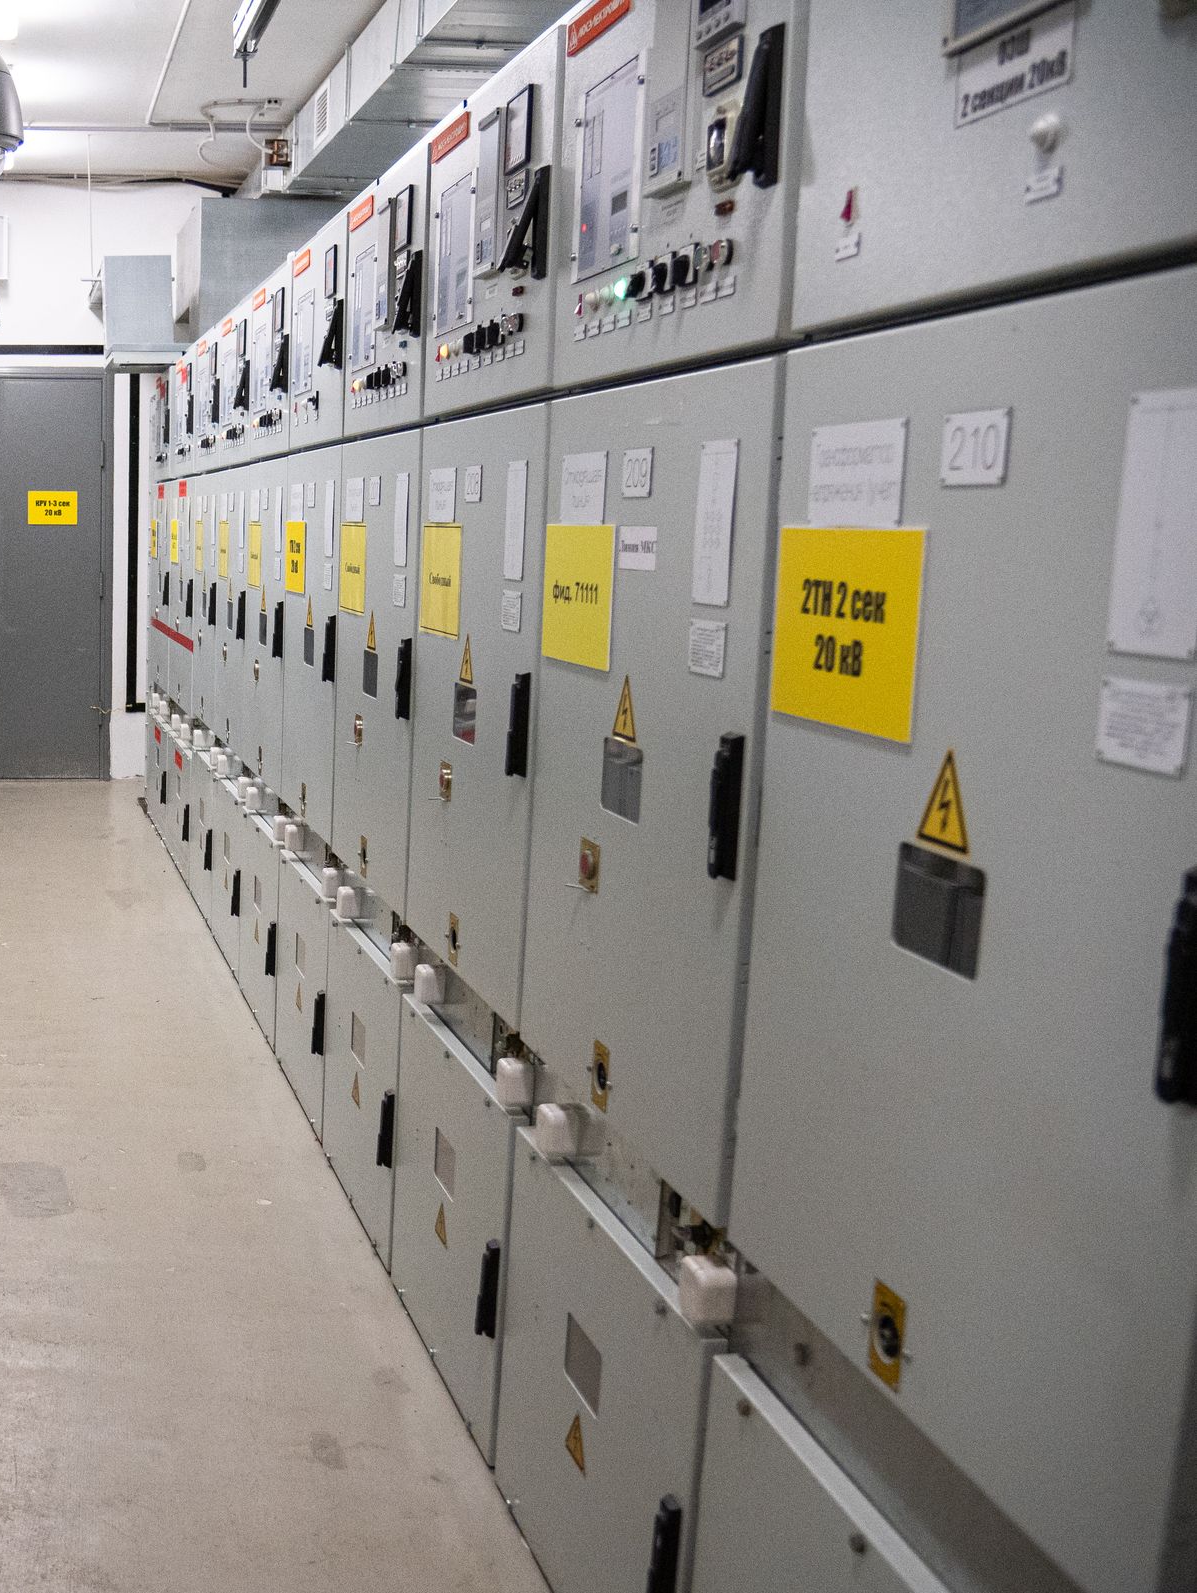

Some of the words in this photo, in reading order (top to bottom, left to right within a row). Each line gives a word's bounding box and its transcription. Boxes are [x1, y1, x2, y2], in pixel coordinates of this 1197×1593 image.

[948, 424, 1001, 471] 210
[625, 458, 647, 488] 209
[575, 581, 598, 605] 71111
[801, 578, 833, 617] 2ТН
[835, 581, 848, 619] 2
[851, 588, 886, 625] сек
[813, 634, 836, 673] 20
[839, 639, 863, 678] кВ
